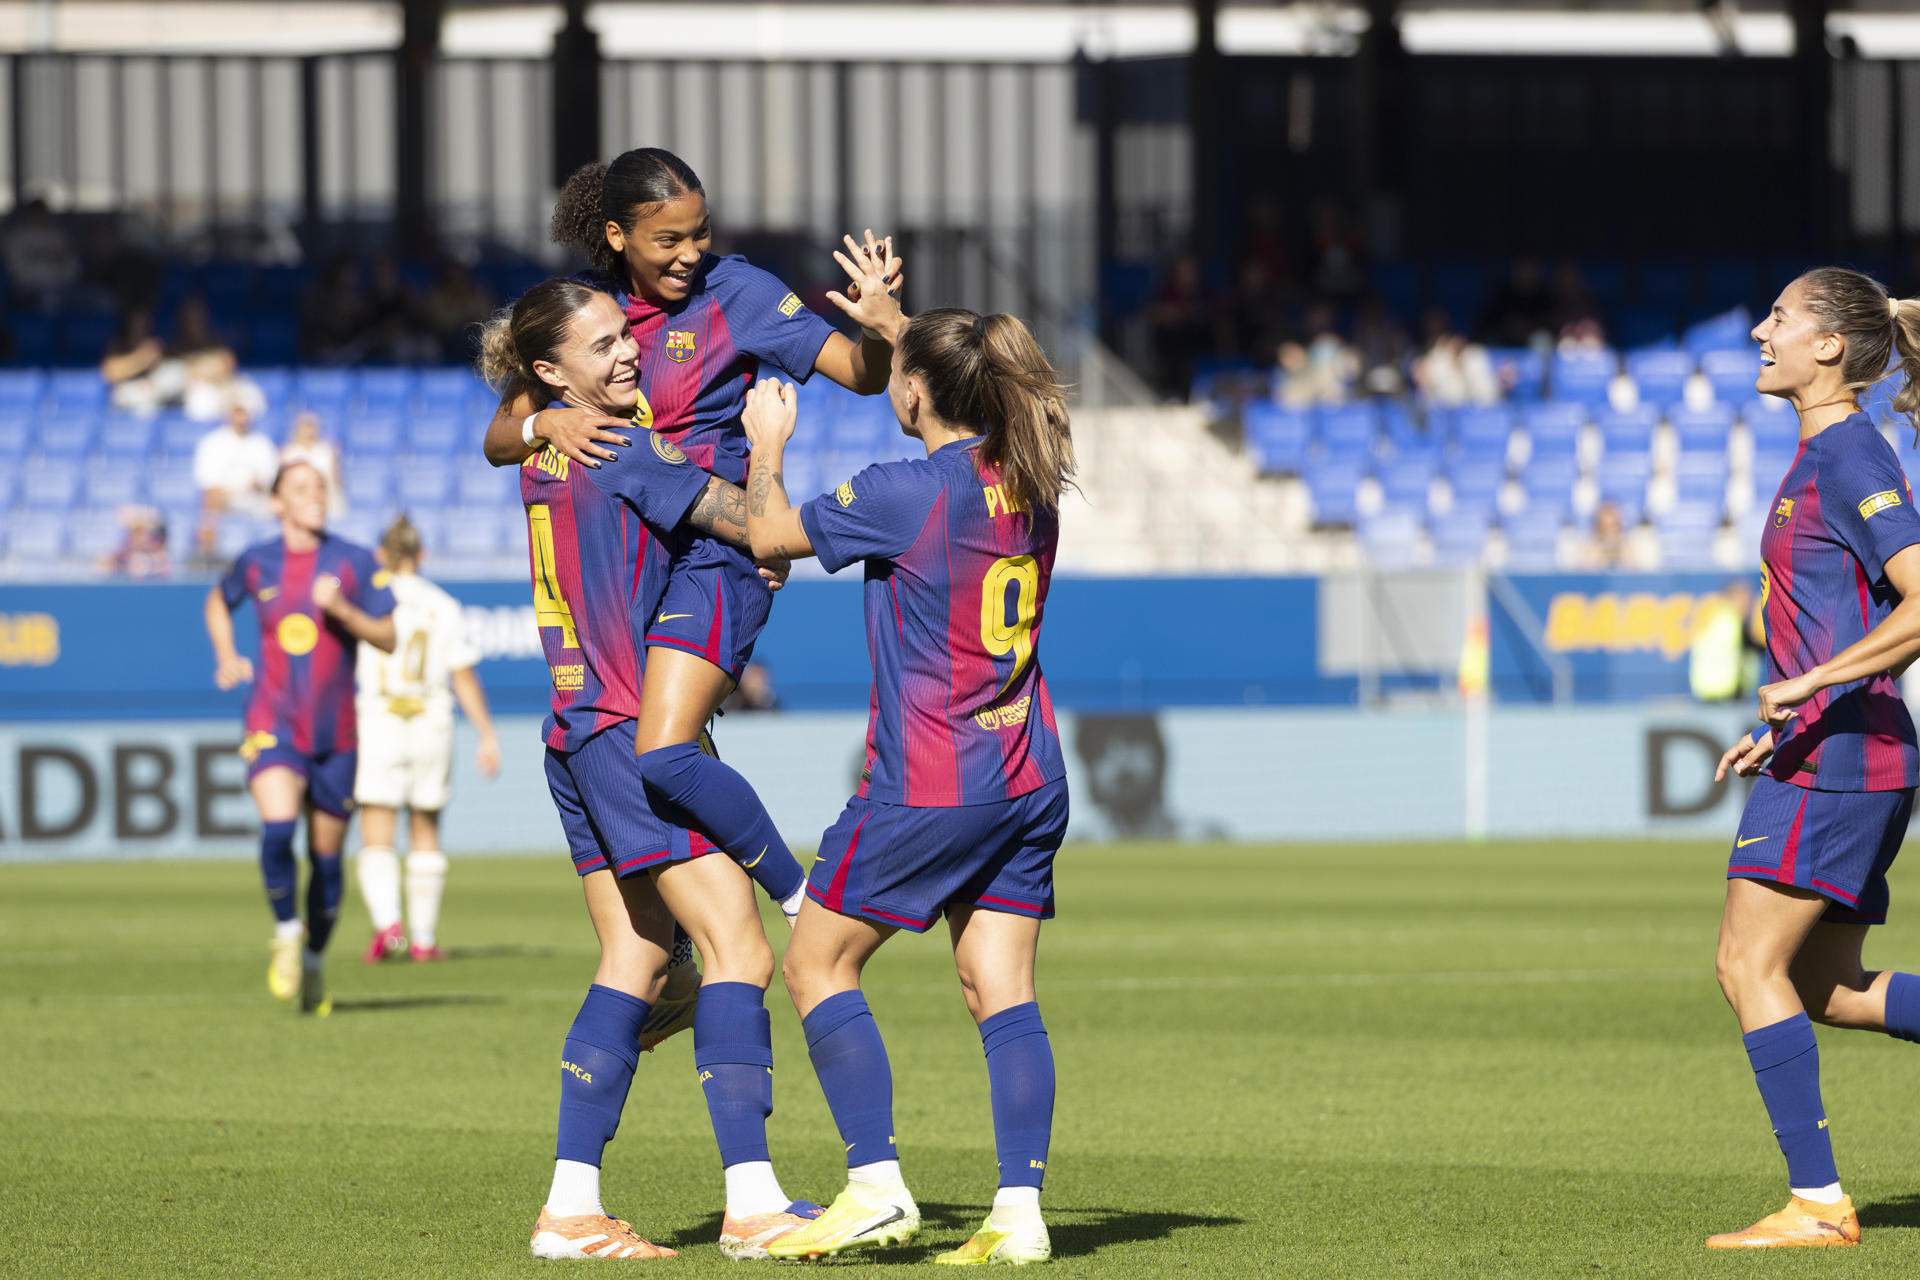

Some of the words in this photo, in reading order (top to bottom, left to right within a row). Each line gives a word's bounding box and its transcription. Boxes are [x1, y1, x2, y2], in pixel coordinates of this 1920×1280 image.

[528, 504, 581, 649] 4
[555, 665, 584, 676] UNHCR
[981, 554, 1039, 699] 9
[556, 675, 584, 686] ACNUR
[0, 742, 258, 837] DBE
